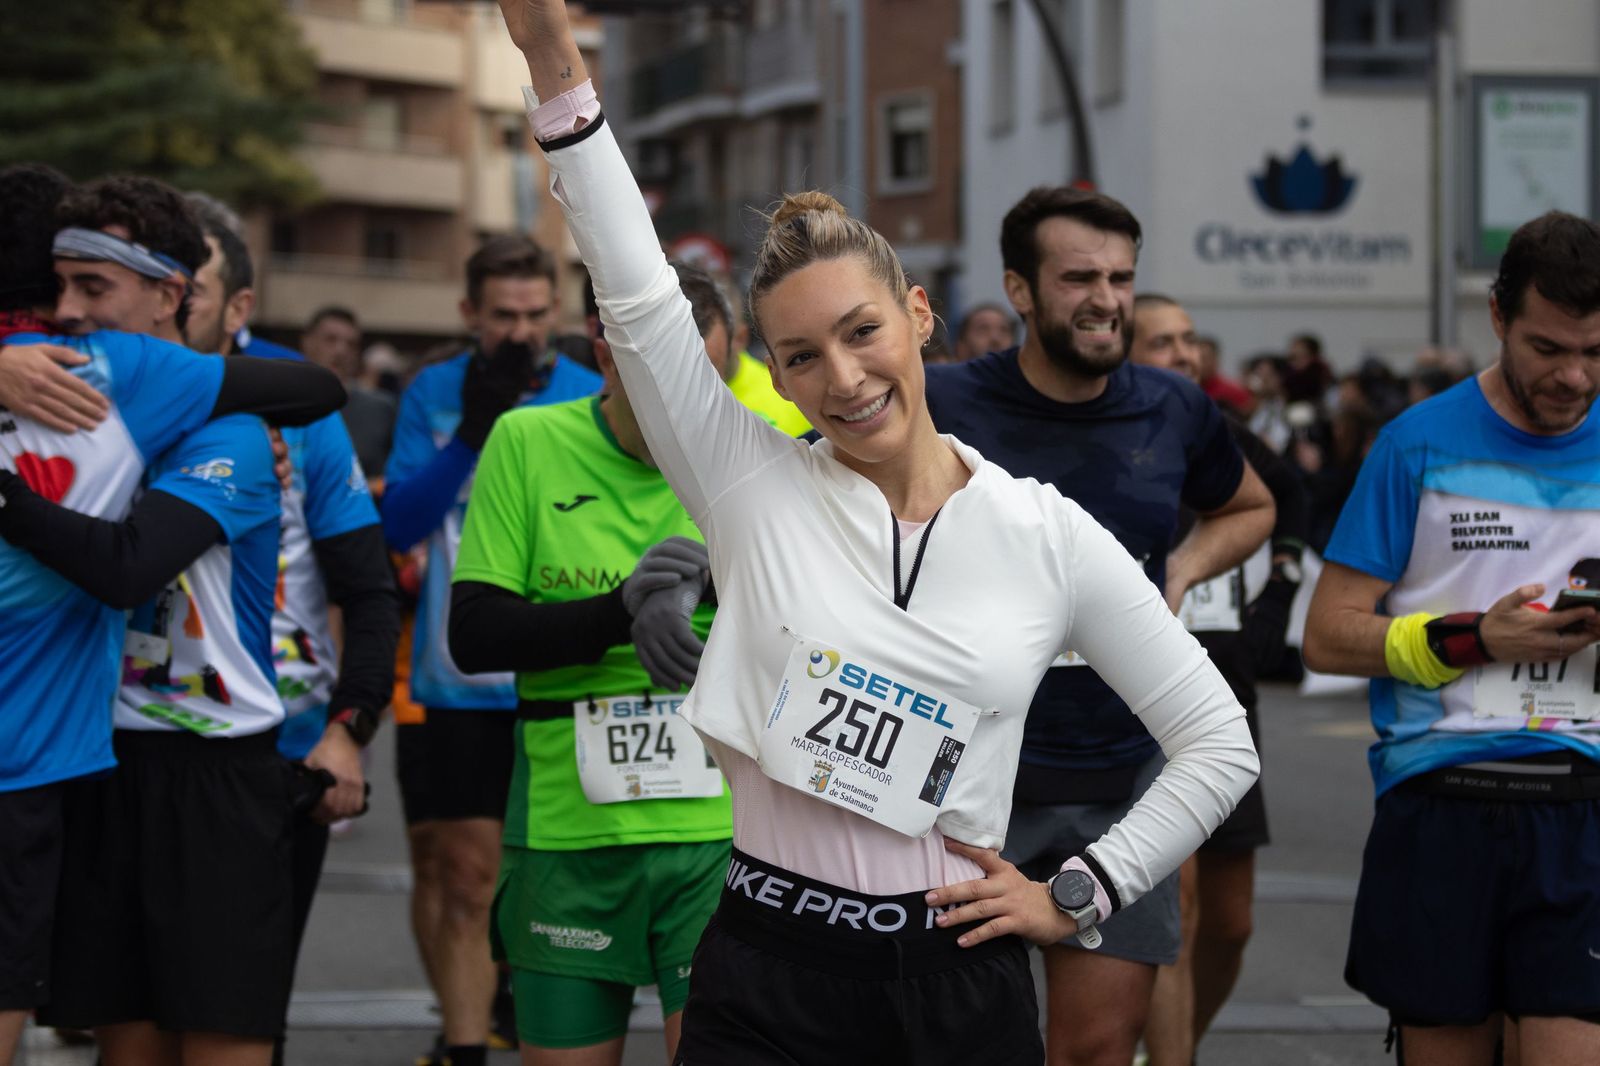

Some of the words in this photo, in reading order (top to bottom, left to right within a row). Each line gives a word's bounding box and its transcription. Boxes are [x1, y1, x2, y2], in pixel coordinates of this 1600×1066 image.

[1450, 513, 1469, 523] XLI
[1474, 512, 1500, 521] SAN
[1451, 526, 1514, 537] SILVESTRE
[1452, 540, 1530, 551] SALMANTINA
[839, 663, 954, 729] SETEL
[805, 688, 904, 769] 250
[607, 722, 676, 764] 624
[950, 750, 961, 764] 250
[829, 788, 839, 798] de
[839, 792, 875, 814] Salamanca
[832, 777, 879, 803] Ayuntamiento
[792, 887, 907, 932] PRO
[530, 922, 602, 941] SANMAXIMO
[550, 936, 596, 949] TELECOM
